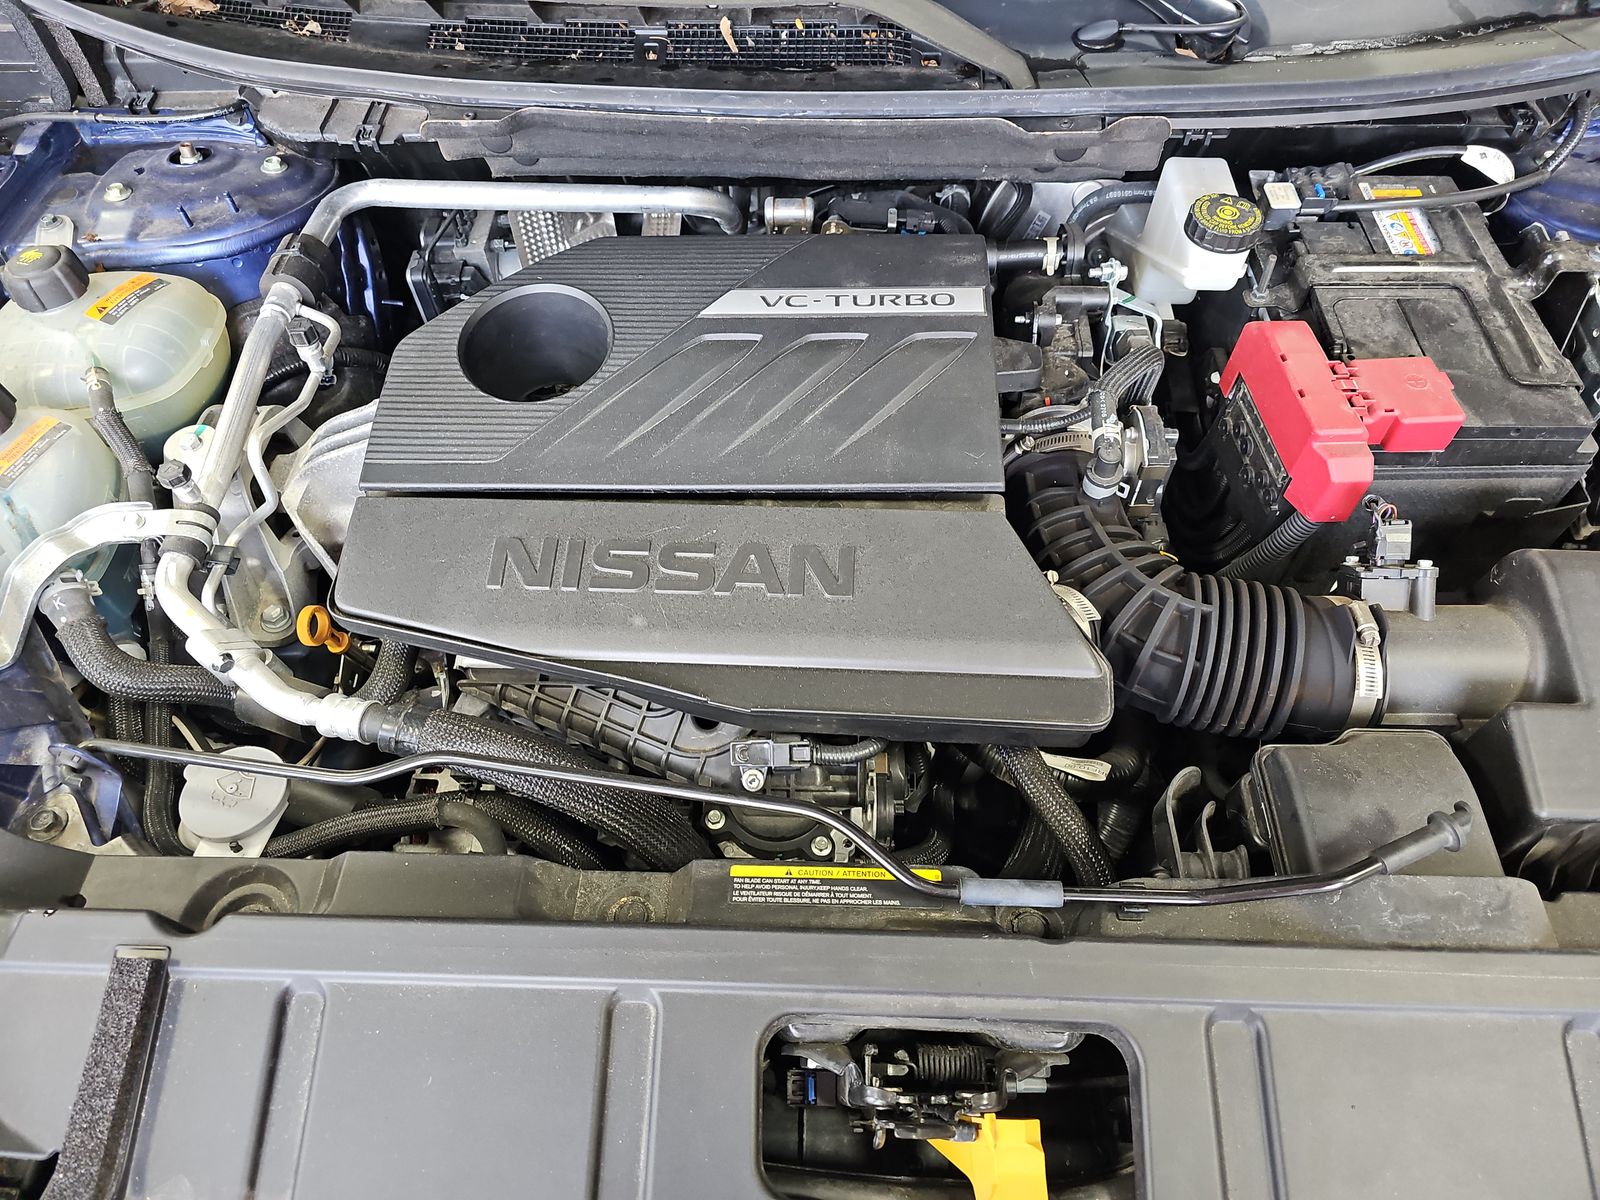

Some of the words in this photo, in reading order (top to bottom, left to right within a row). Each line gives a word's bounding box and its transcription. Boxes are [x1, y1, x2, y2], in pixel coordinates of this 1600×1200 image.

[759, 292, 956, 309] VC-TURBO
[485, 536, 856, 598] NISSAN
[798, 869, 834, 877] CAUTION
[842, 870, 886, 878] ATTENTION
